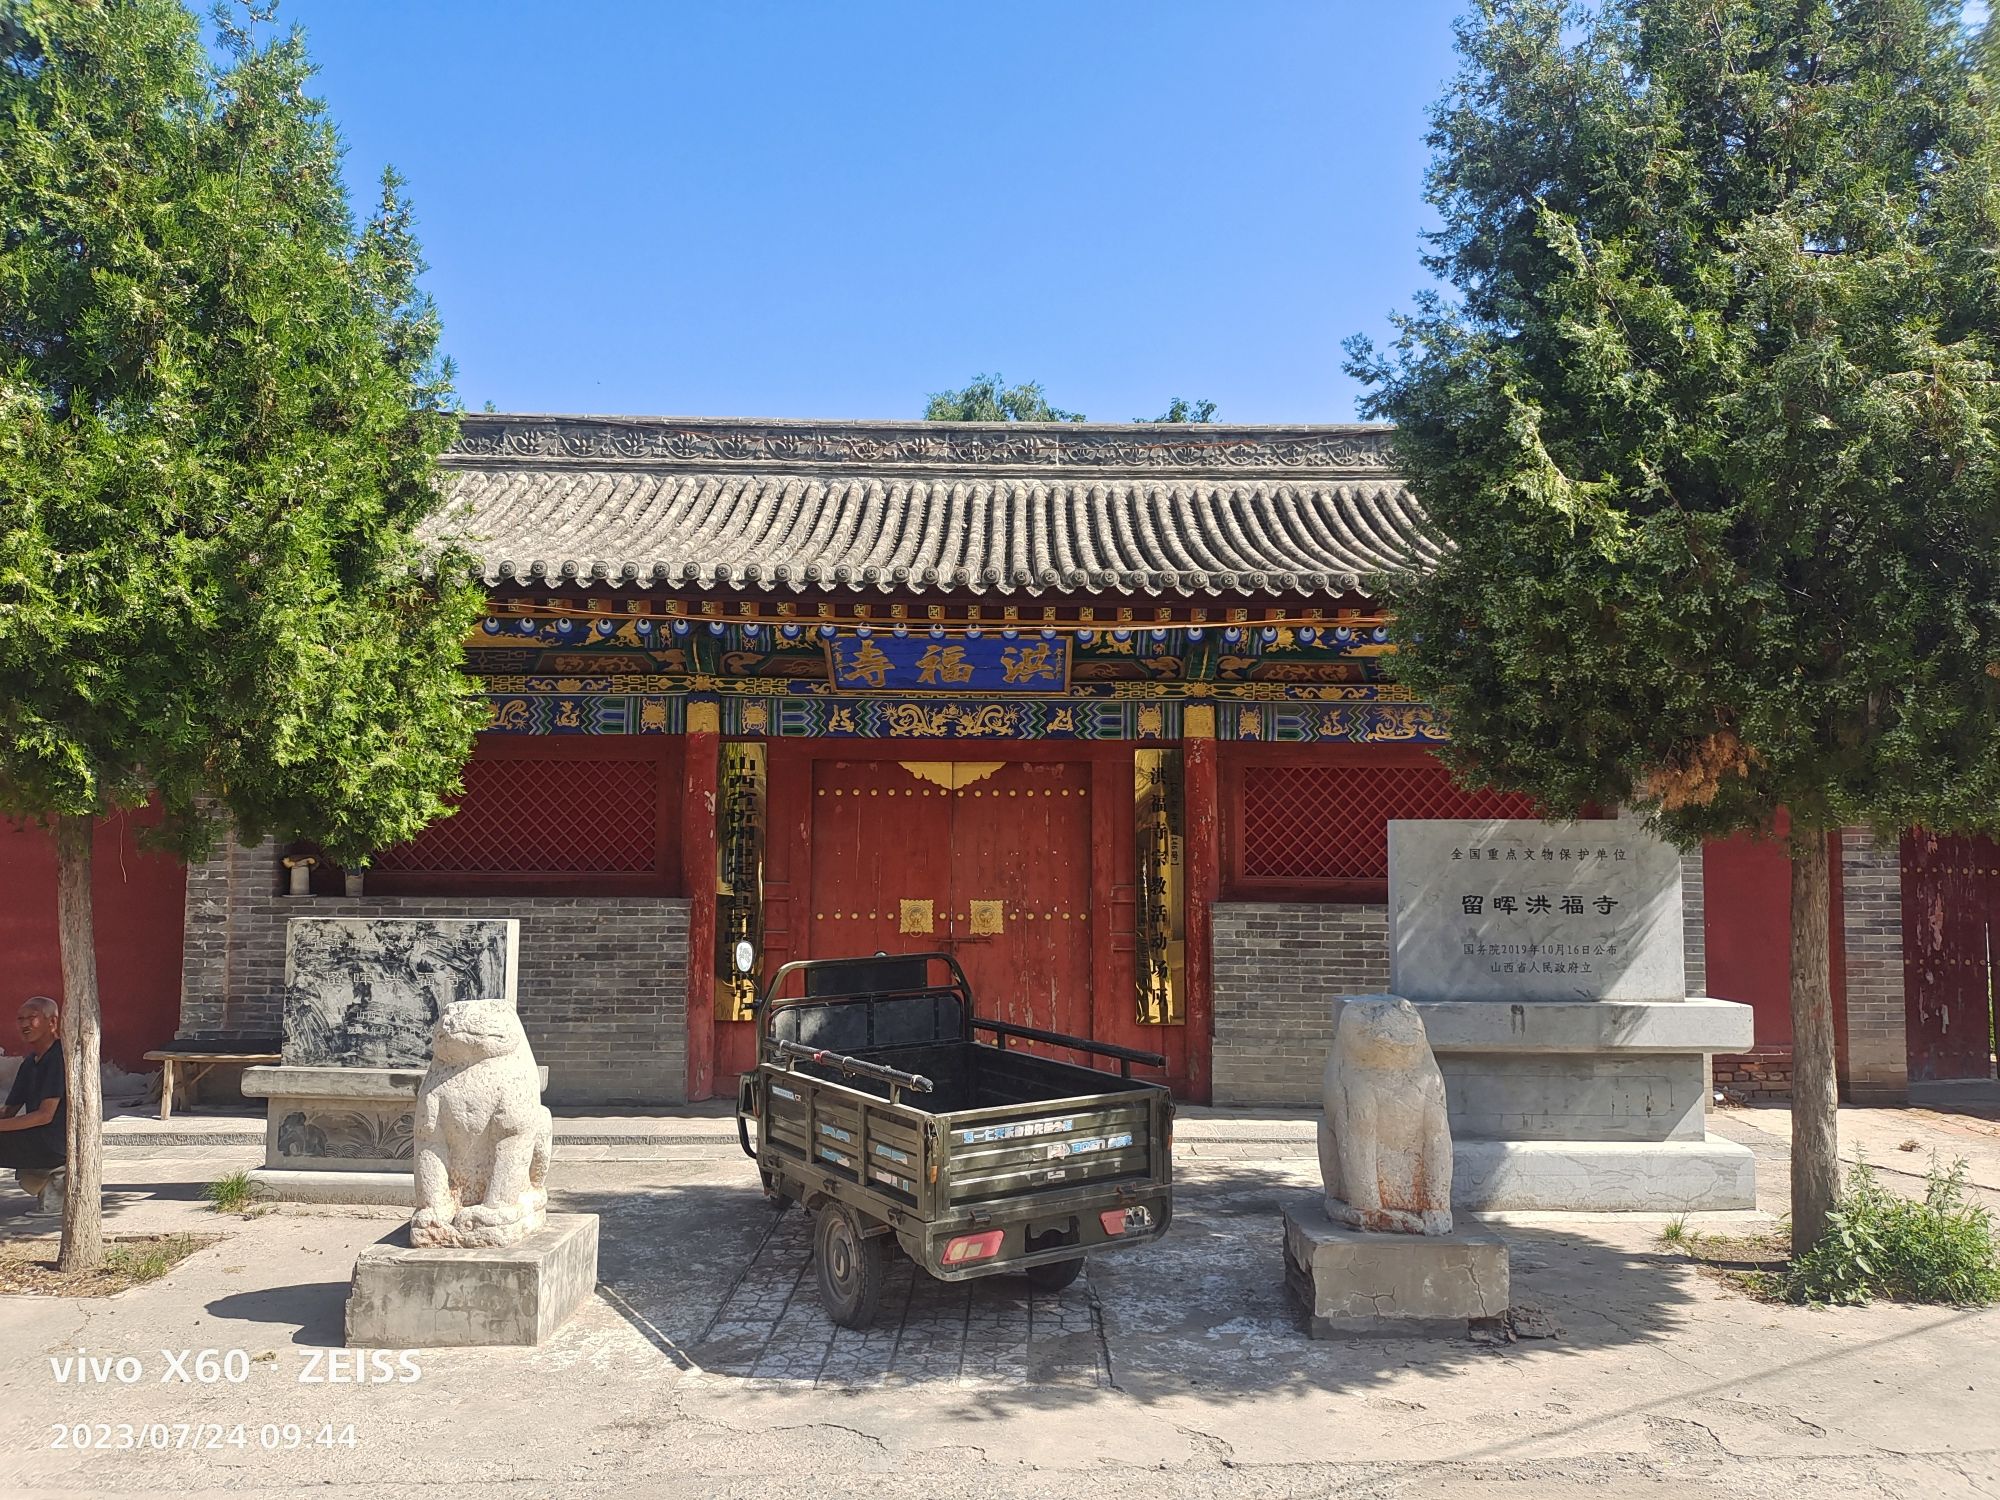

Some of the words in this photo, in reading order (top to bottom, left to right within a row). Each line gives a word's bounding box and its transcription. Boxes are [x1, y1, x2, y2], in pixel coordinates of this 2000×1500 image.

[843, 639, 1056, 688] 洪福寺
[1450, 847, 1628, 862] 全国重点文物保护单位
[1149, 766, 1169, 1007] 洪福寺宗教活动场所
[1461, 894, 1619, 916] 留晖洪福寺
[1463, 943, 1618, 957] 国务院2019年10月16日公布
[1490, 961, 1593, 974] 山西省人民政府立
